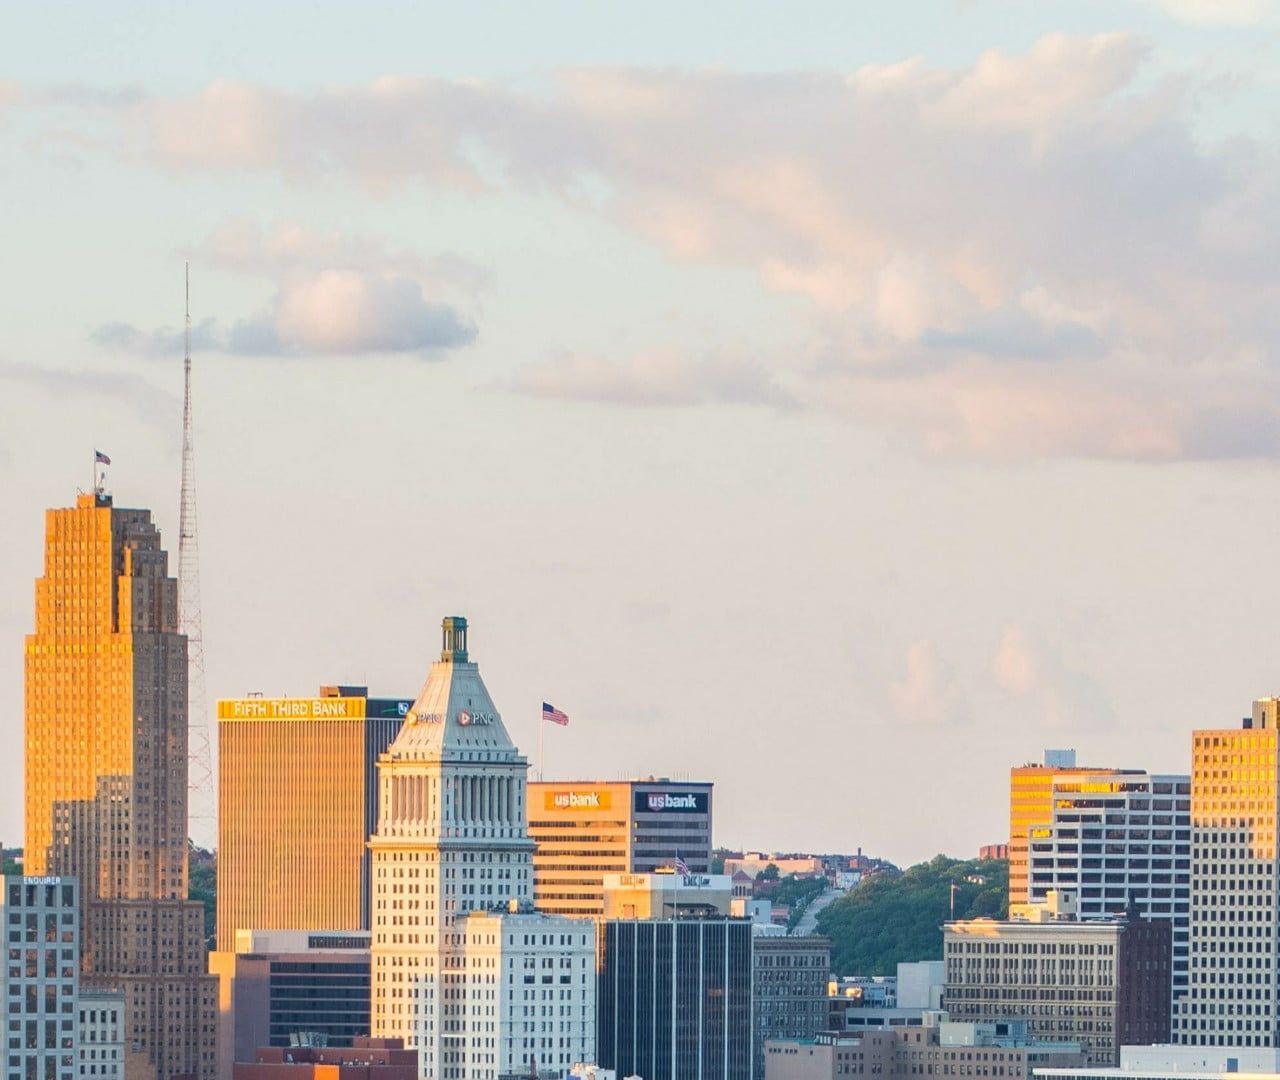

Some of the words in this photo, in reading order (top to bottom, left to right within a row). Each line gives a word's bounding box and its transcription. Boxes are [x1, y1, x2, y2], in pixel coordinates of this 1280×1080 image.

[234, 702, 266, 715] FIFTH
[272, 702, 308, 715] THIRD
[312, 701, 347, 714] BANK
[472, 712, 495, 725] PNC
